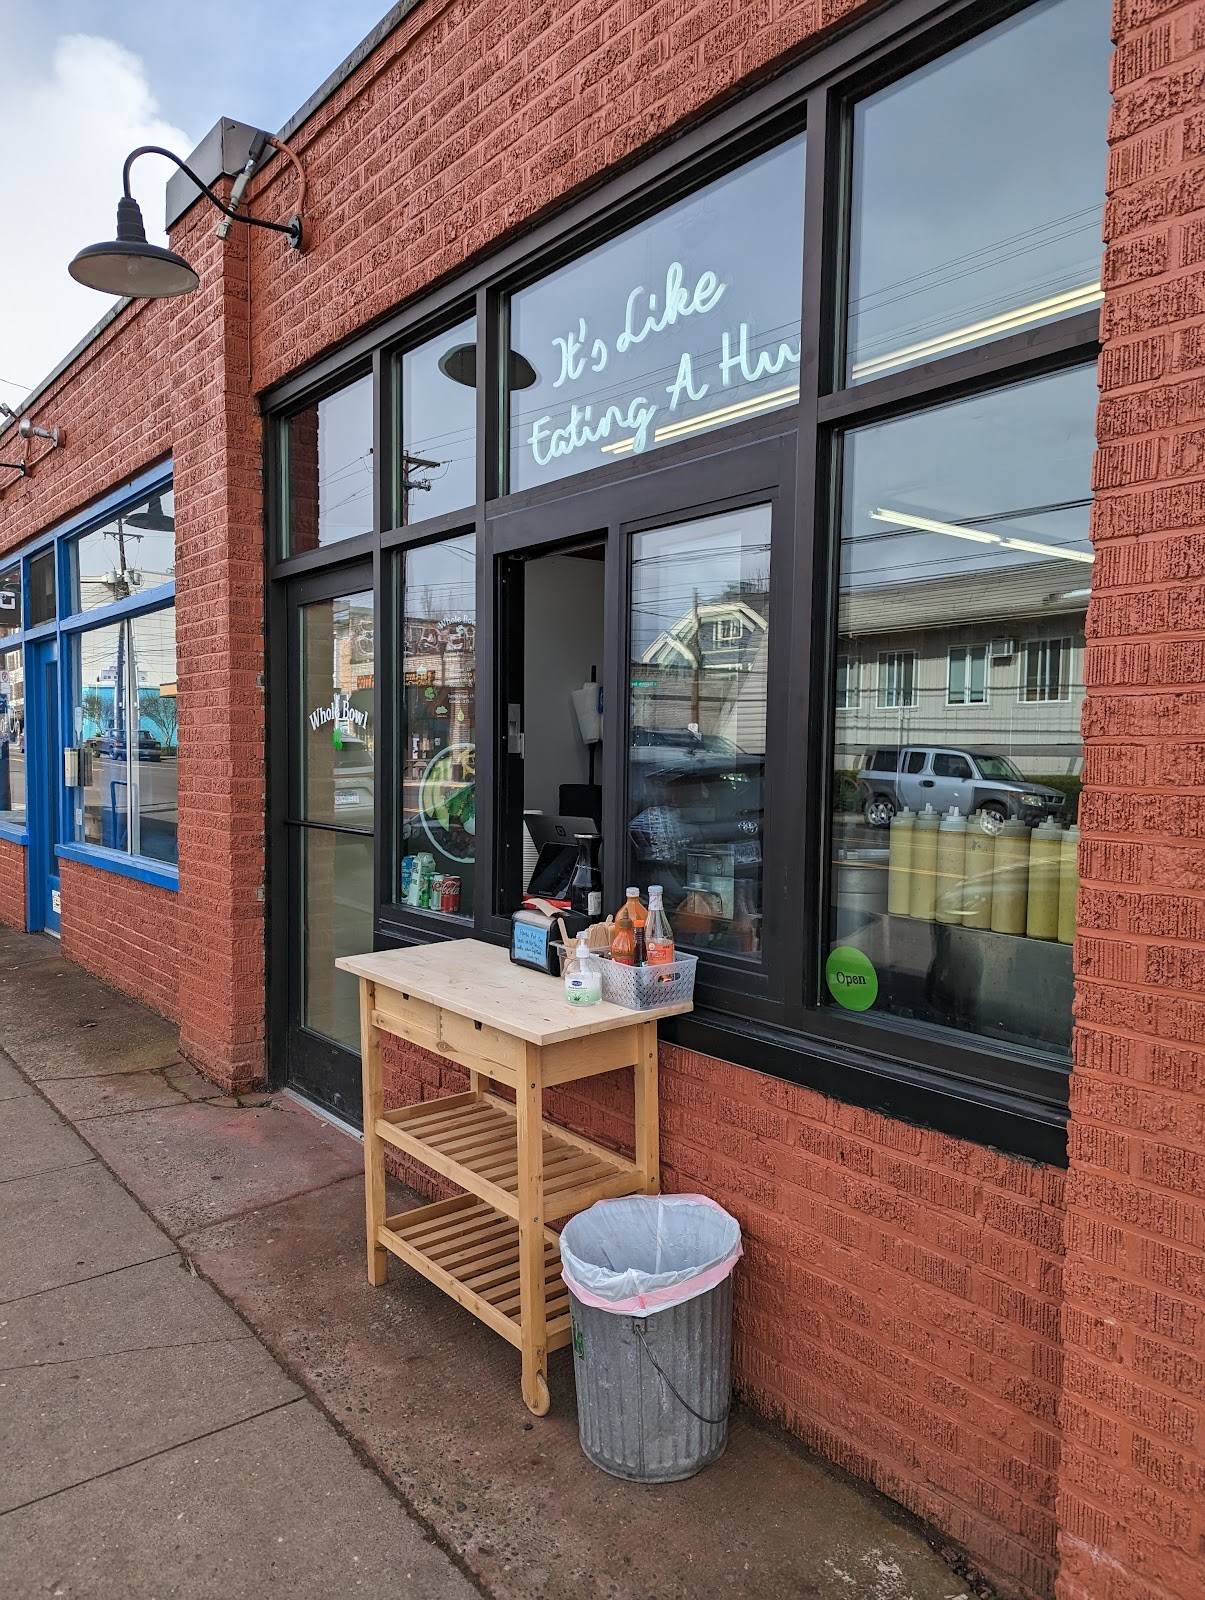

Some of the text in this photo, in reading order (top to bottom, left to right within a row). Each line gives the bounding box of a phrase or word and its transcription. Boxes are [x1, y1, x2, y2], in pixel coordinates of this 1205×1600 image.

[552, 261, 729, 388] It's Like
[527, 322, 802, 466] Eating A Hu
[463, 614, 476, 627] Bow
[308, 700, 369, 731] Whole Bowl
[836, 971, 867, 987] Open
